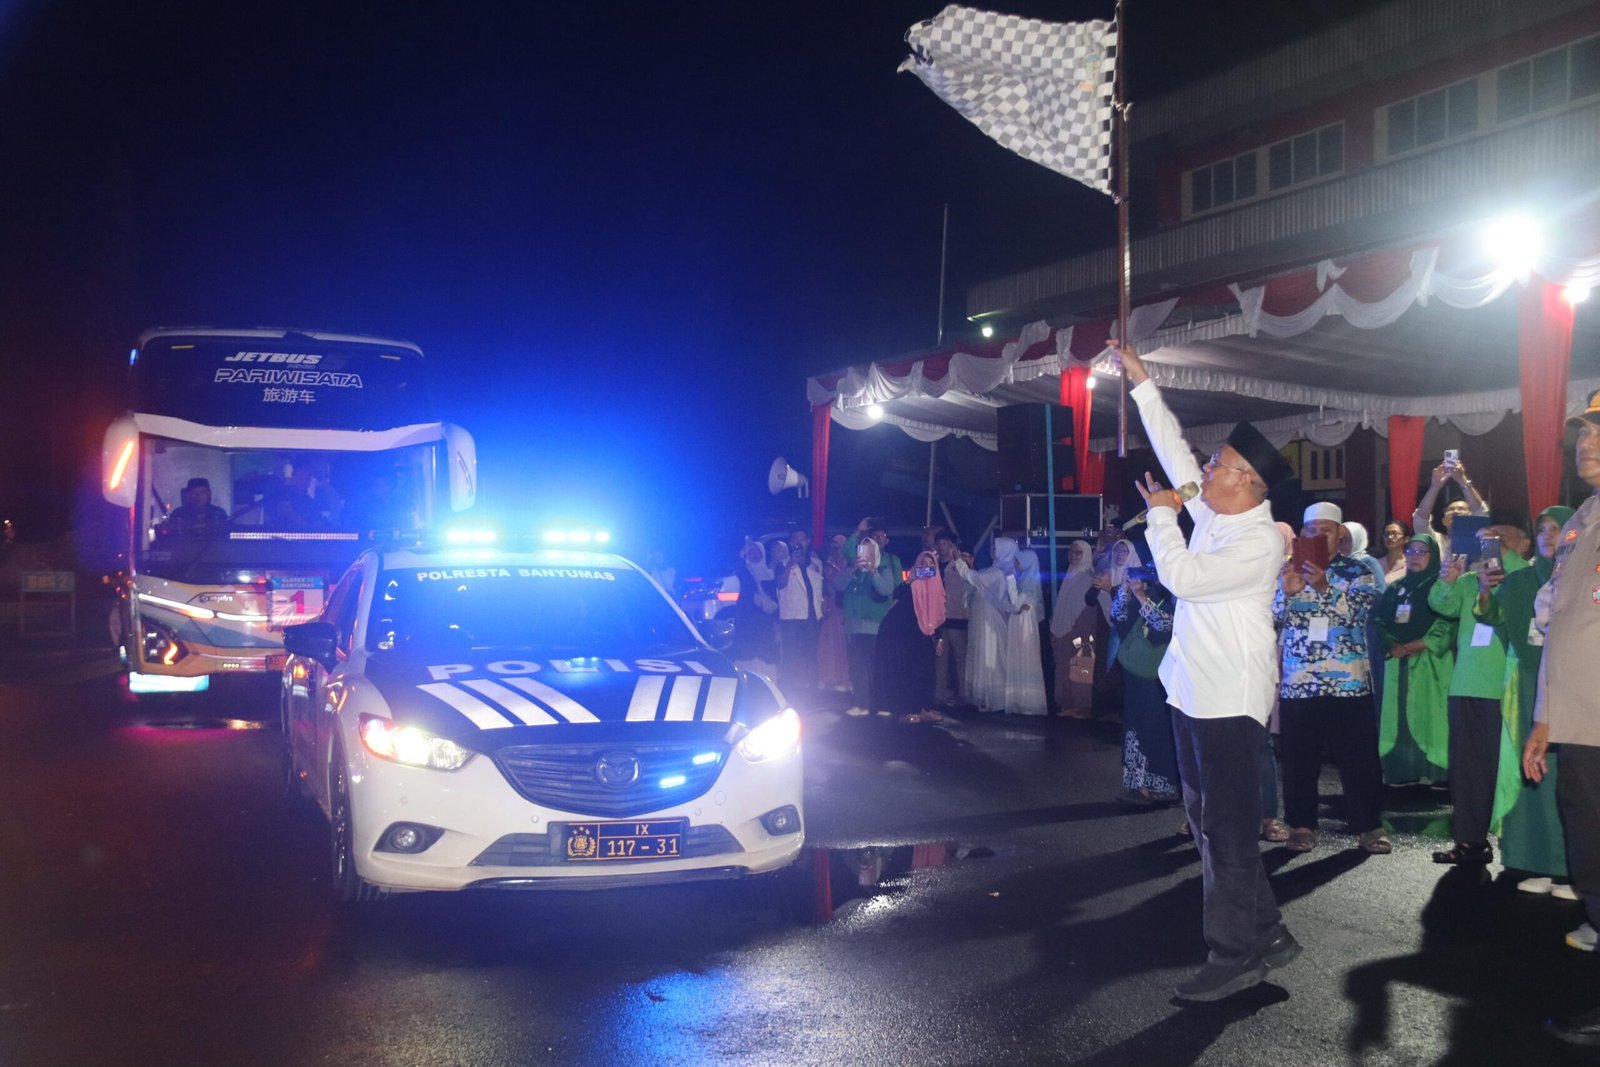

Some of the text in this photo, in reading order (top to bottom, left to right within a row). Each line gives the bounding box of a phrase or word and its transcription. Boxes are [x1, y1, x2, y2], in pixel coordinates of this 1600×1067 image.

[225, 352, 322, 364] JETBUS
[214, 368, 363, 388] PARIWISATA
[263, 387, 316, 404] 旅游车
[417, 568, 615, 581] POLRESTA BANYUMAS
[290, 590, 304, 613] 1
[427, 659, 713, 680] POLISI
[635, 824, 649, 835] IX
[607, 840, 636, 856] 117
[657, 838, 678, 854] 31
